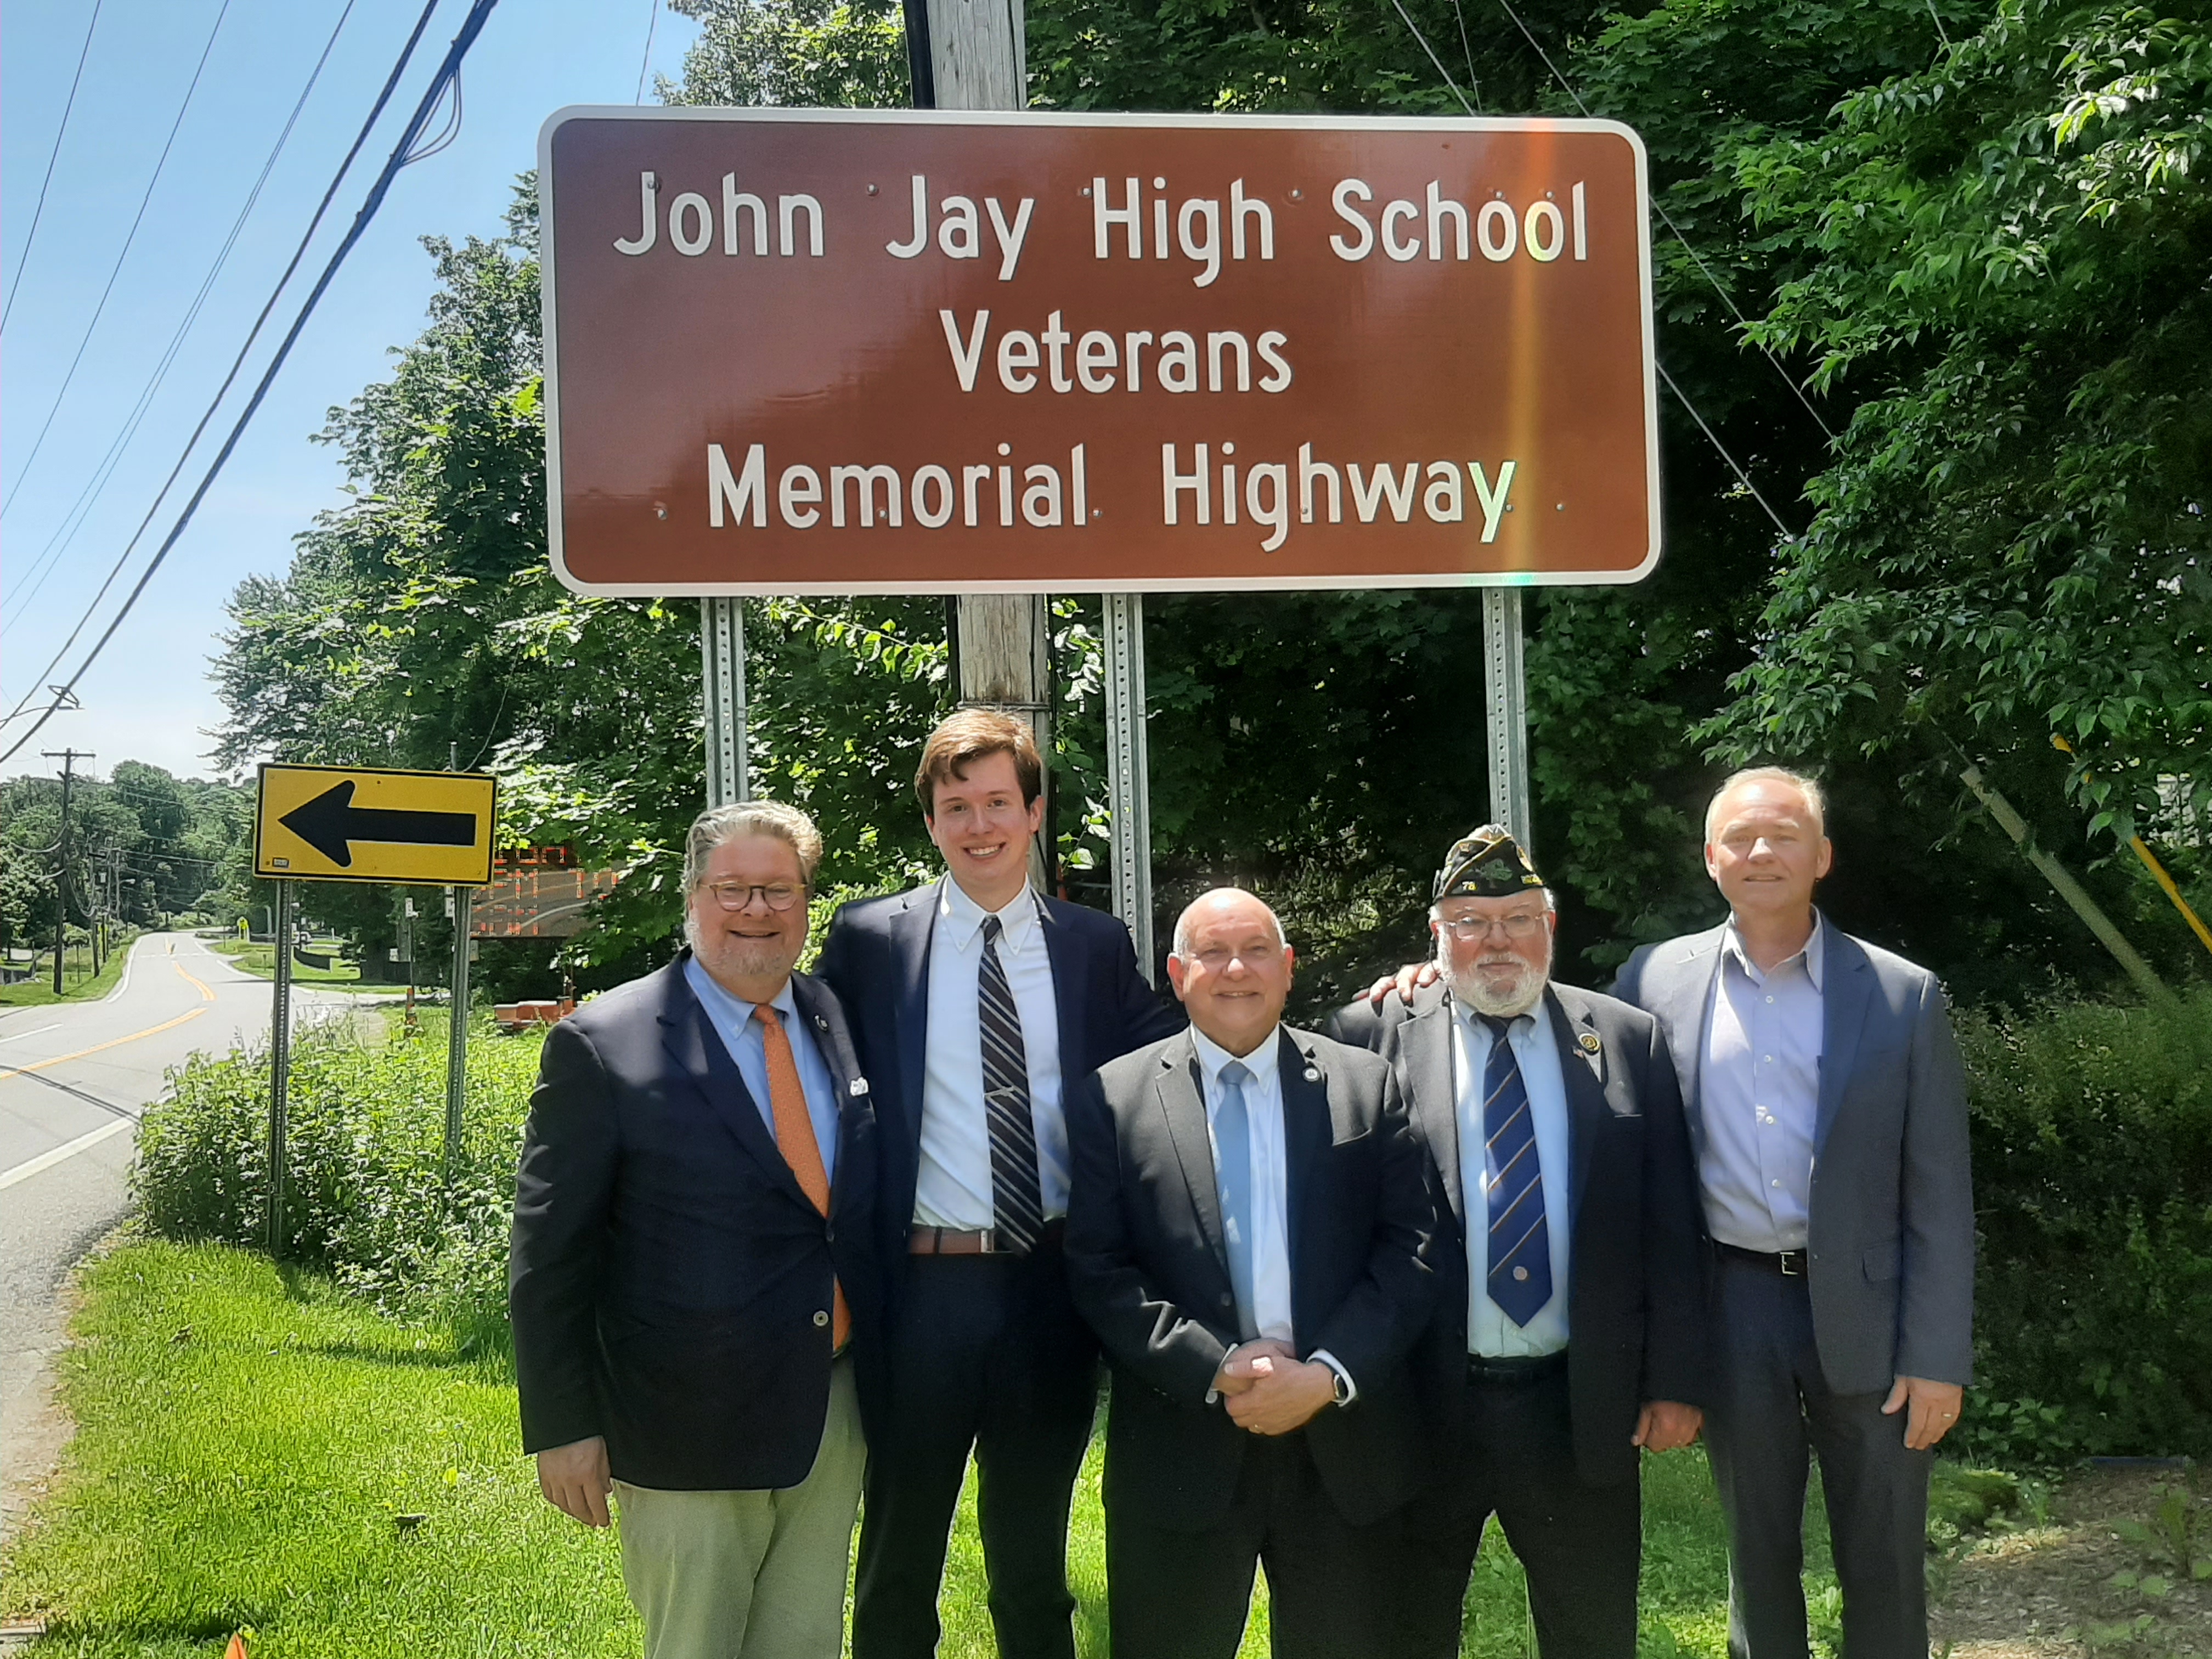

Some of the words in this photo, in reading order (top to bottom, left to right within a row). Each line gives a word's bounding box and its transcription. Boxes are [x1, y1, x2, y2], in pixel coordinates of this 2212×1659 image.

[613, 171, 824, 257] John
[885, 174, 1035, 281] Jay
[1093, 177, 1275, 288] High
[1329, 178, 1587, 262] School
[939, 309, 1292, 393] Veterans
[707, 443, 1086, 528] Memorial
[1161, 441, 1516, 552] Highway
